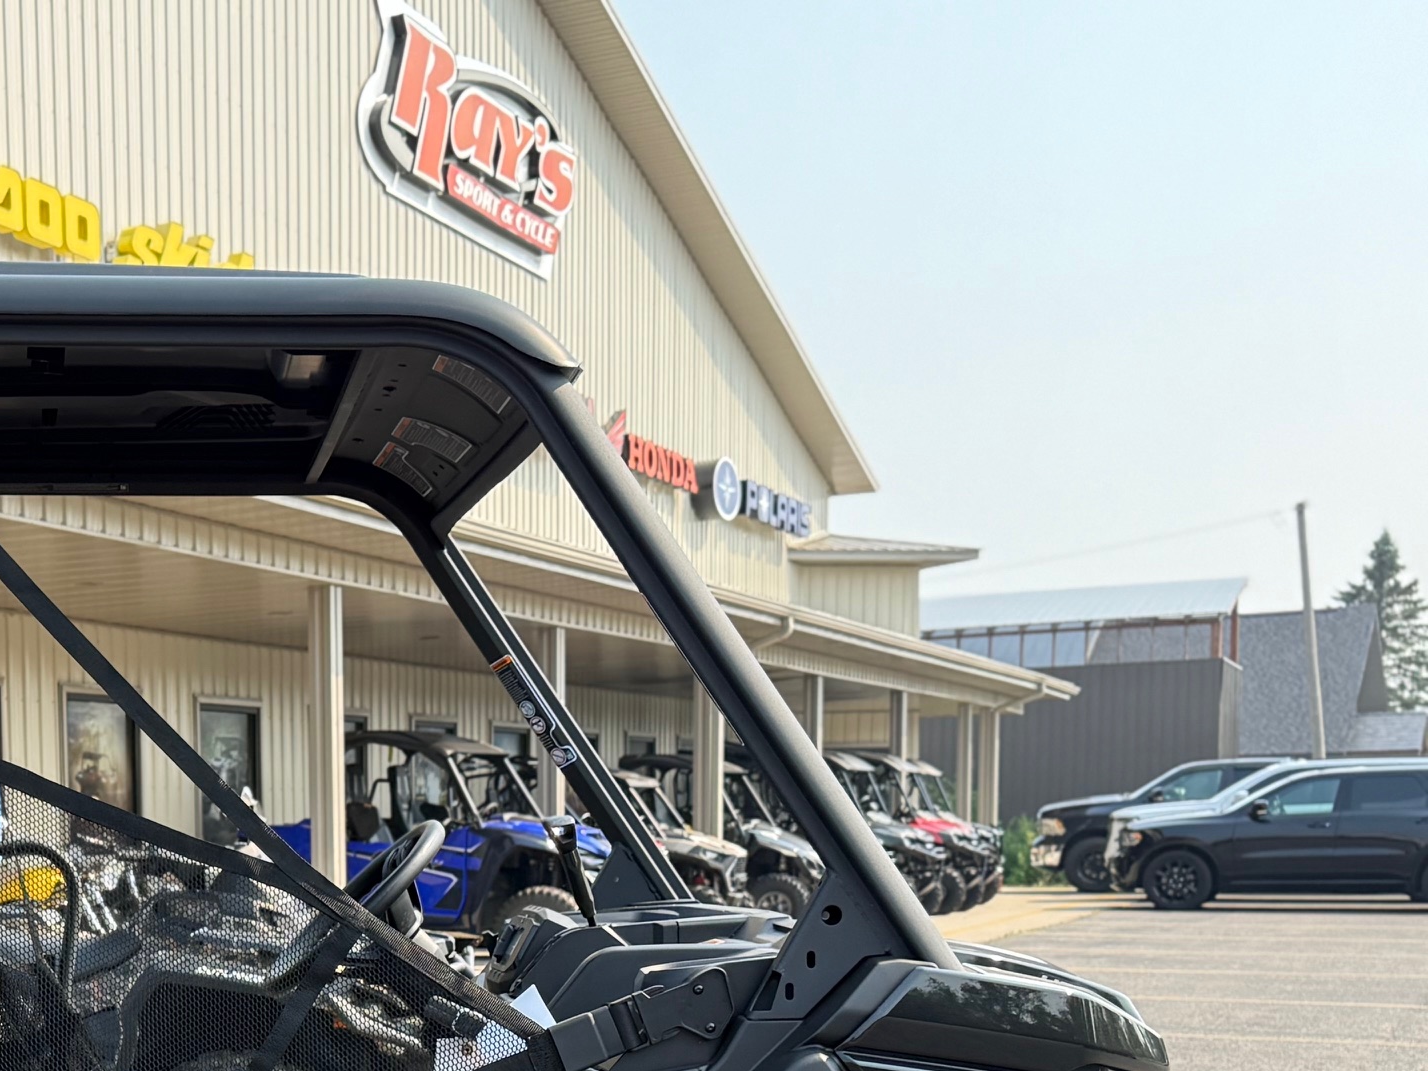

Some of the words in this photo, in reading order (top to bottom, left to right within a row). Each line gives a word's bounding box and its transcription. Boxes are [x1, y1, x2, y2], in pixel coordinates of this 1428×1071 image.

[453, 170, 499, 218] SPORT
[500, 204, 514, 228] &
[515, 213, 556, 248] CYCLE
[628, 434, 699, 494] HONDA
[743, 479, 812, 537] POLARIS
